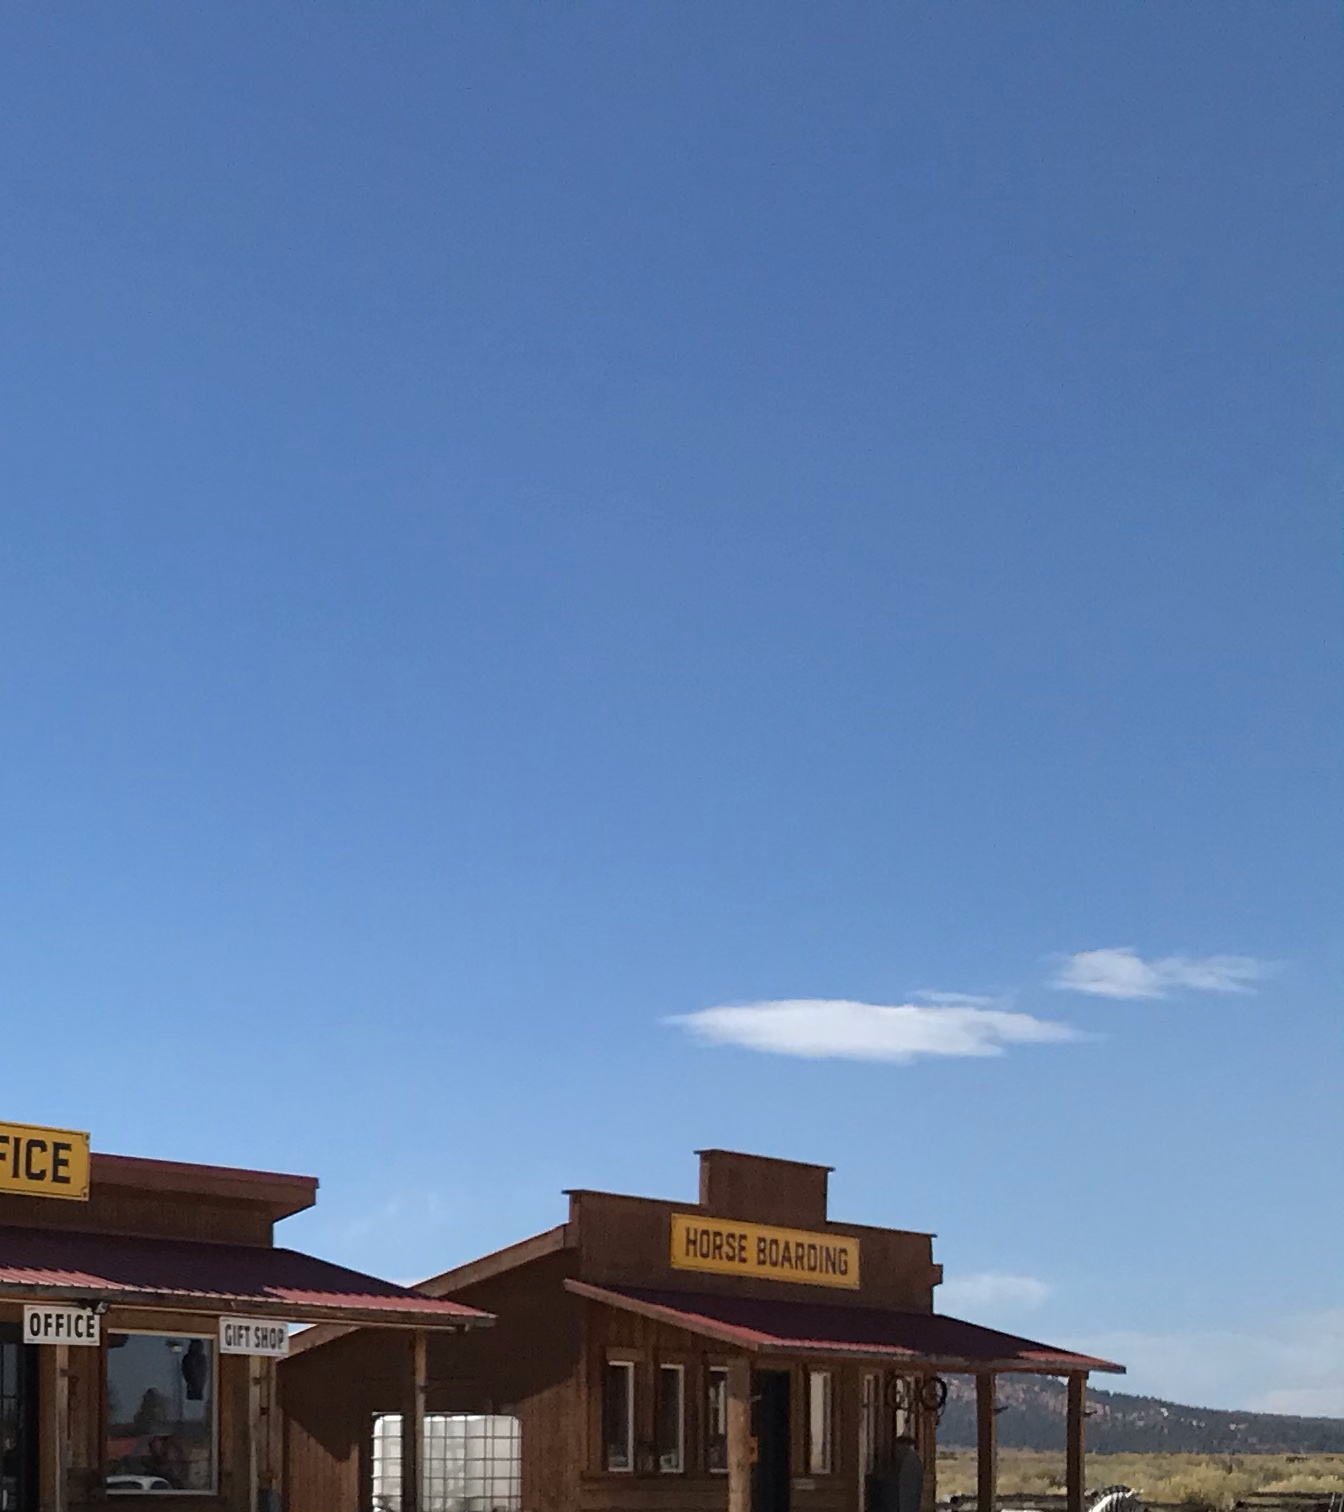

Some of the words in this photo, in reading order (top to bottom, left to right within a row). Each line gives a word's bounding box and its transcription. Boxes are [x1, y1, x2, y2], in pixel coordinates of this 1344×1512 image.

[685, 1227, 748, 1264] HORSE
[757, 1237, 848, 1275] BOARDING
[29, 1313, 95, 1338] OFFICE
[225, 1324, 250, 1347] GIFT
[254, 1327, 285, 1349] SHOP
